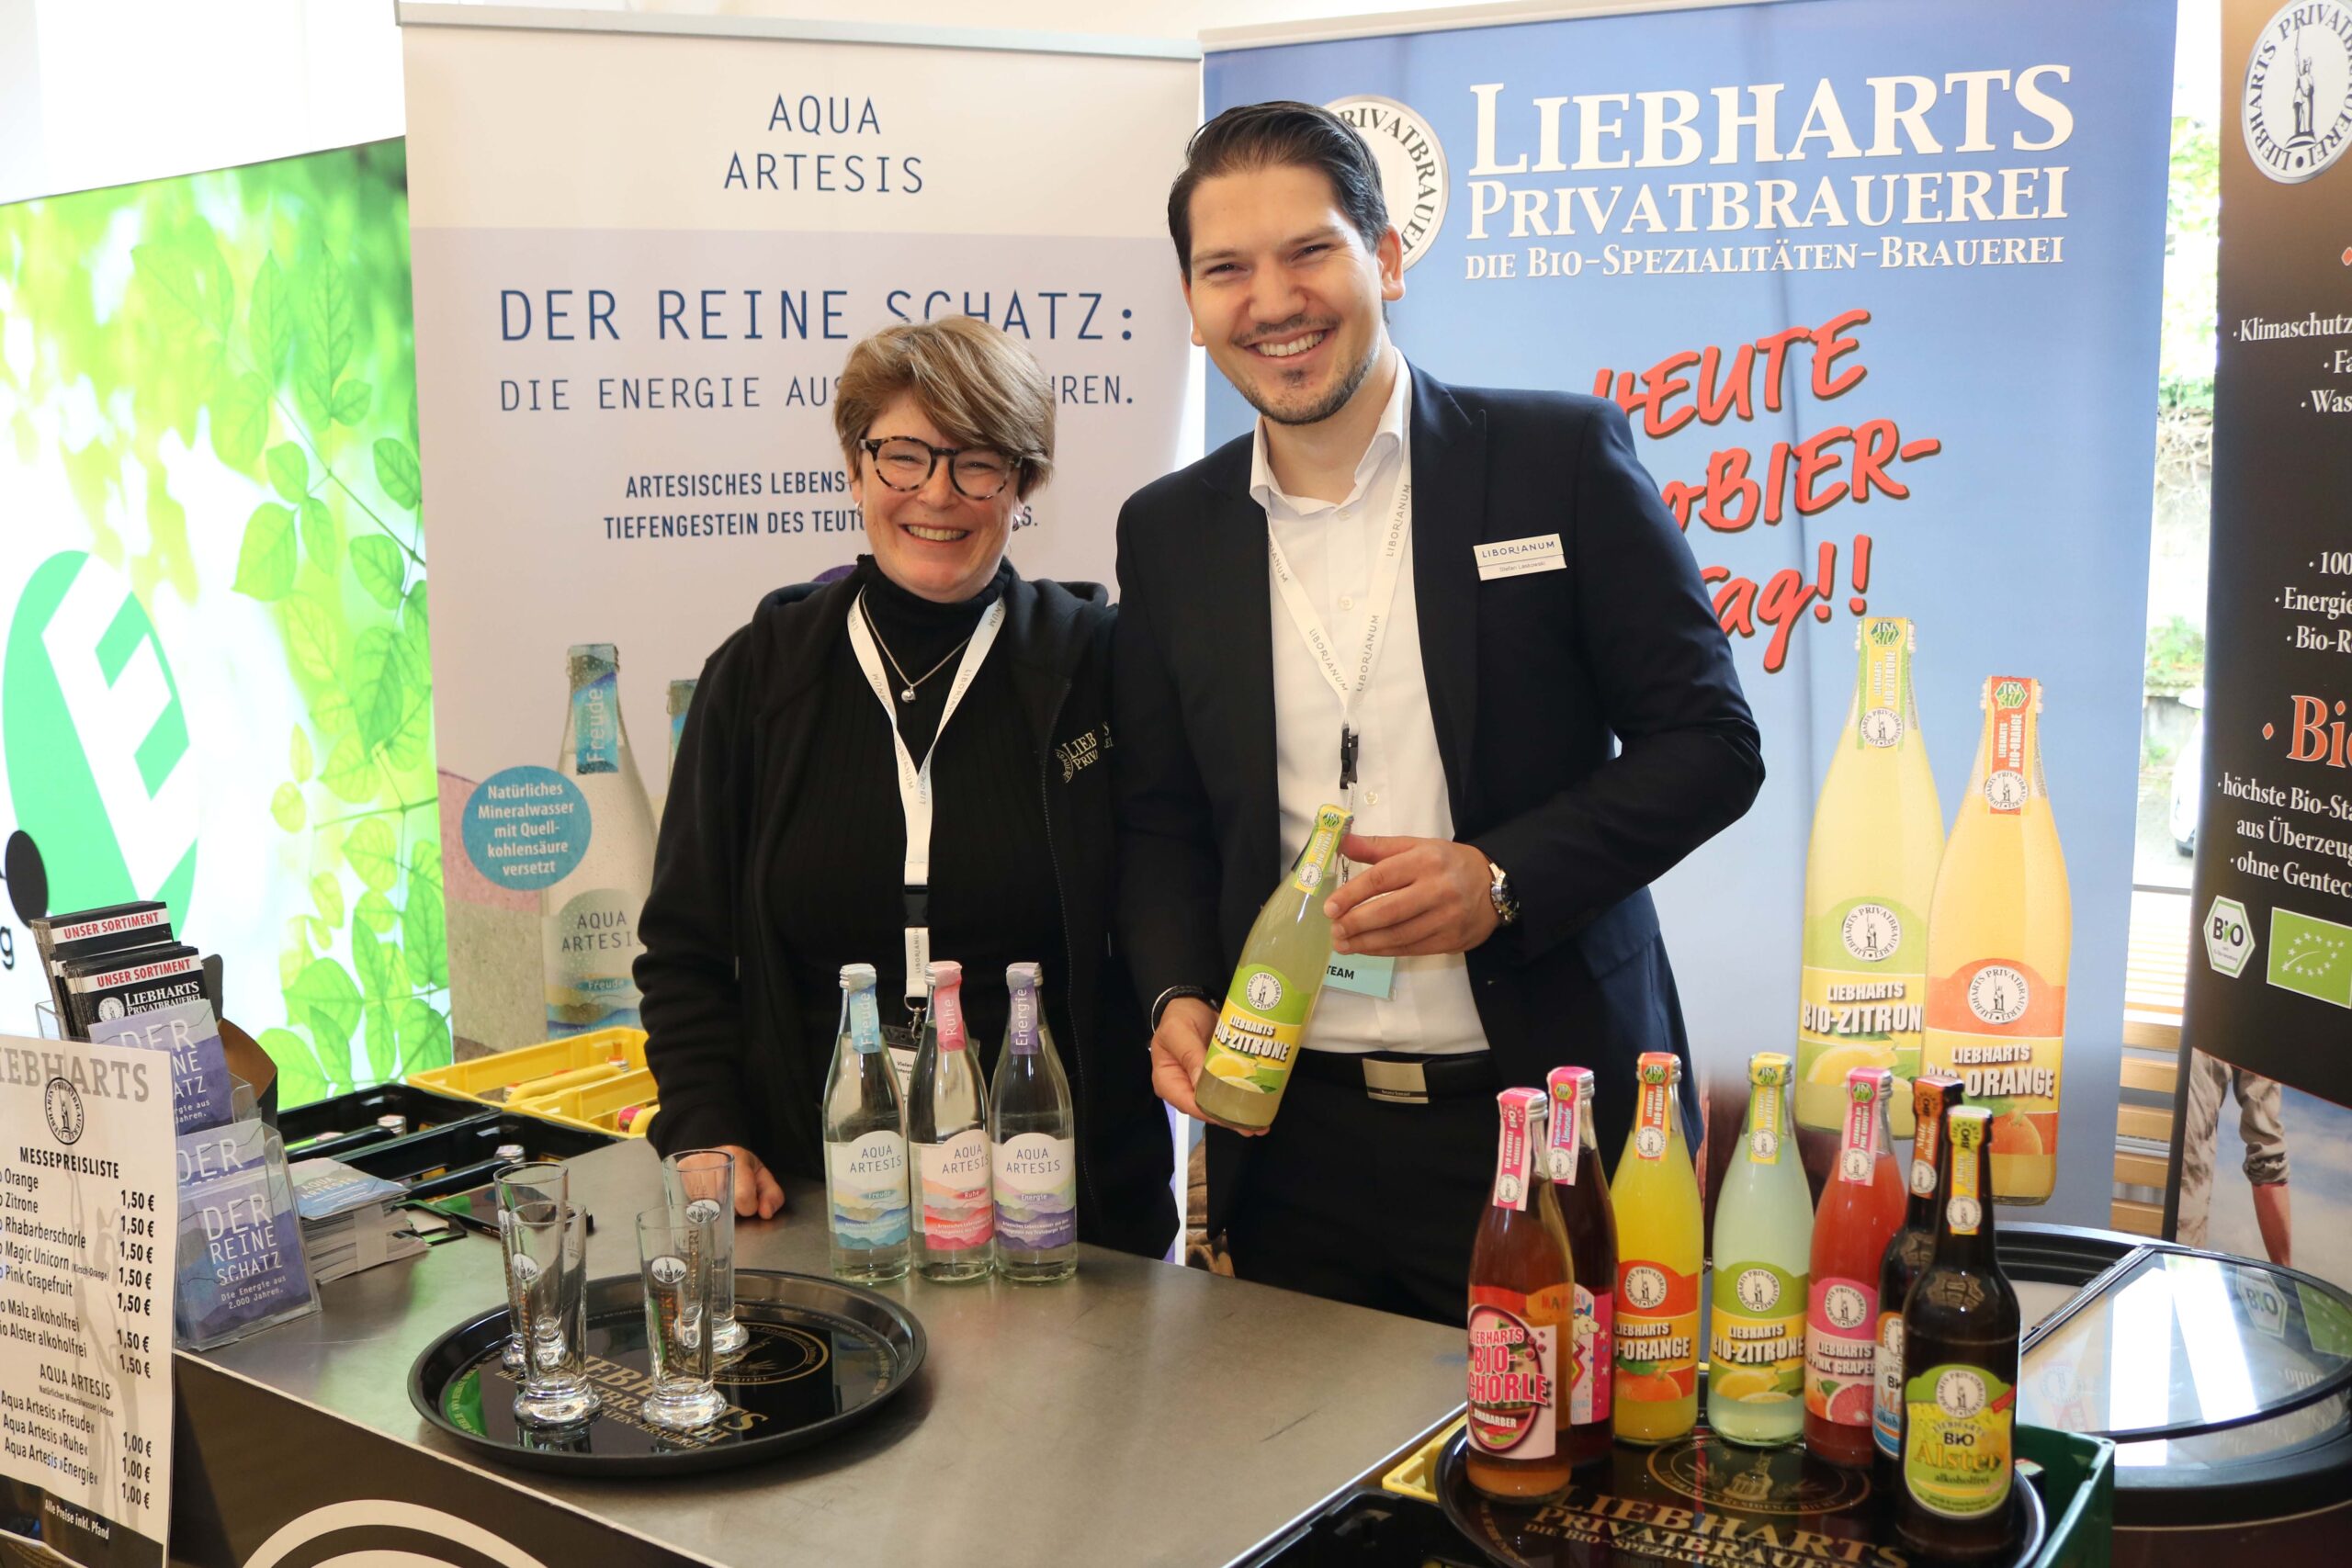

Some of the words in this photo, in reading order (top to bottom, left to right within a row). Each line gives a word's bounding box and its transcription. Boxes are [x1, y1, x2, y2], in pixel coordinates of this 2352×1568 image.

[768, 94, 882, 136] AQUA
[1469, 63, 2074, 176] LIEBHARTS
[724, 151, 923, 195] ARTESIS
[1467, 166, 2070, 240] PRIVATBRAUEREI
[501, 288, 618, 342] DER
[659, 289, 850, 341] REINE
[1593, 309, 1871, 440] HEUTE
[501, 379, 570, 412] DIE
[598, 377, 761, 411] ENERGIE
[626, 473, 763, 498] ARTESISCHES
[771, 471, 851, 496] LEBENS
[604, 513, 761, 540] TIEFENGESTEIN
[767, 512, 805, 534] DES
[1385, 484, 1411, 558] LIBORIANUM
[1482, 541, 1555, 558] LIBORIANUM
[1309, 628, 1349, 692] LIBORIANUM
[1356, 615, 1379, 692] LIBORIANUM
[586, 688, 604, 763] Freude
[487, 783, 563, 799] Natürliches
[2223, 773, 2286, 807] höchste
[478, 803, 574, 819] Mineralwasser
[494, 824, 516, 838] mit
[520, 820, 560, 838] Quell-
[2236, 818, 2265, 840] aus
[487, 840, 568, 858] kohlensäure
[503, 861, 556, 876] versetzt
[2236, 851, 2279, 881] ohne
[2282, 861, 2352, 899] Gentec
[63, 923, 99, 939] UNSER
[102, 912, 159, 932] SORTIMENT
[577, 910, 627, 930] AQUA
[561, 931, 642, 953] ARTESI
[96, 971, 132, 987] UNSER
[134, 958, 190, 980] SORTIMENT
[1326, 965, 1355, 980] TEAM
[124, 981, 199, 1006] LIEBHARTS
[1826, 983, 1904, 1001] LIEBHARTS
[861, 993, 871, 1046] Freude
[945, 998, 956, 1037] Ruhe
[1015, 987, 1027, 1046] Energie
[1231, 1015, 1274, 1036] LIEBHARTS
[1804, 1002, 1922, 1033] BIO-ZITRON
[1951, 1044, 2030, 1064] LIEBHARTS
[196, 1100, 210, 1109] aus
[19, 1146, 119, 1179] MESSEPREISLISTE
[850, 1156, 901, 1173] ARTESIS
[862, 1145, 892, 1158] AQUA
[943, 1154, 989, 1174] ARTESIS
[955, 1145, 982, 1159] AQUA
[1006, 1160, 1060, 1174] ARTESIS
[1016, 1147, 1048, 1160] AQUA
[5, 1168, 39, 1192] Orange
[121, 1190, 144, 1210] 1,50
[148, 1194, 154, 1212] €
[965, 1190, 979, 1199] Ruhe
[6, 1192, 39, 1213] Zitrone
[120, 1215, 144, 1235] 1,50
[147, 1220, 154, 1238] €
[203, 1193, 273, 1241] DER
[6, 1216, 86, 1249] Rhabarberschorle
[119, 1241, 143, 1261] 1,50
[146, 1247, 153, 1264] €
[209, 1226, 277, 1265] REINE
[5, 1240, 31, 1264] Magic
[34, 1245, 69, 1271] Unicorn
[119, 1267, 142, 1288] 1,50
[145, 1272, 153, 1290] €
[217, 1251, 283, 1286] SCHATZ
[6, 1264, 25, 1284] Pink
[27, 1269, 73, 1297] Grapefruit
[118, 1292, 141, 1314] 1,50
[144, 1299, 151, 1316] €
[221, 1292, 235, 1302] Die
[239, 1281, 270, 1297] Energie
[273, 1275, 287, 1285] aus
[228, 1296, 251, 1310] 2.000
[254, 1288, 284, 1302] Jahren.
[8, 1299, 29, 1319] Malz
[31, 1305, 80, 1332] alkoholfrei
[117, 1329, 139, 1350] 1,50
[142, 1336, 149, 1353] €
[1730, 1324, 1783, 1338] LIEBHARTS
[10, 1323, 36, 1343] Alster
[39, 1331, 87, 1358] alkoholfrei
[119, 1354, 141, 1375] 1,50
[144, 1361, 151, 1379] €
[1475, 1345, 1516, 1374] BIO-
[1818, 1341, 1871, 1358] LIEBHARTS
[40, 1363, 68, 1385] AQUA
[71, 1372, 111, 1400] ARTESIS
[1, 1390, 24, 1411] Aqua
[26, 1397, 56, 1421] Artesis
[58, 1408, 95, 1434] »Freude«
[3, 1414, 26, 1435] Aqua
[28, 1420, 57, 1445] Artesis
[60, 1432, 88, 1456] »Ruhe«
[123, 1431, 143, 1454] 1,00
[146, 1440, 152, 1459] €
[5, 1438, 27, 1459] Aqua
[28, 1445, 57, 1469] Artesis
[60, 1457, 98, 1485] »Energie«
[122, 1457, 142, 1480] 1,00
[144, 1466, 151, 1483] €
[1914, 1440, 2001, 1472] Alster
[1935, 1473, 1989, 1485] alkoholfrei
[121, 1483, 141, 1505] 1,00
[143, 1492, 150, 1510] €
[45, 1499, 55, 1515] Alle
[56, 1505, 74, 1524] Preise
[74, 1513, 90, 1530] inkl.
[91, 1521, 110, 1540] Pfand
